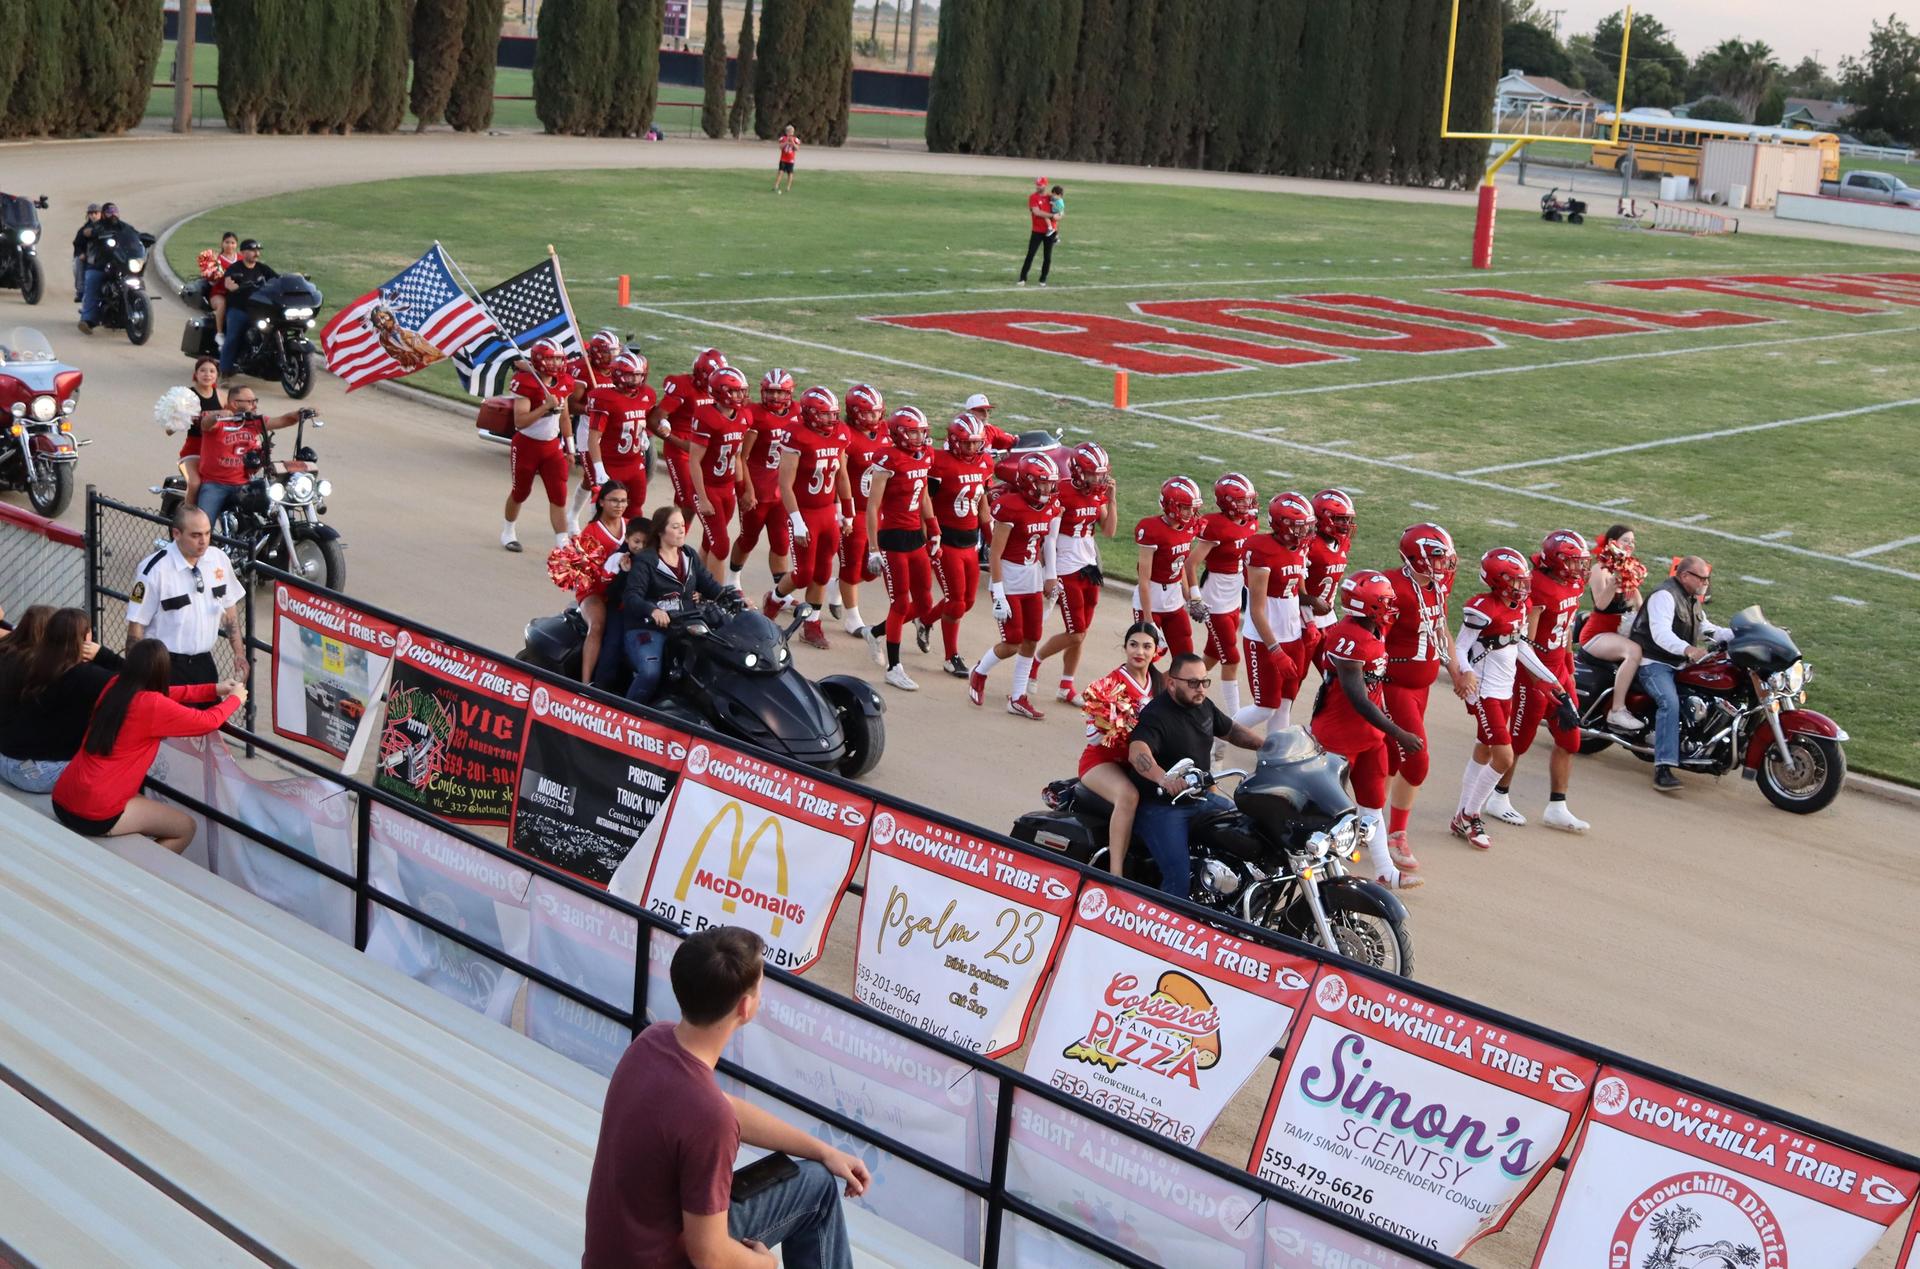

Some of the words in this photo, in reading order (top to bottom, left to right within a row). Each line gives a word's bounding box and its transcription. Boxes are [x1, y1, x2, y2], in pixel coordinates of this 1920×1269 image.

[860, 288, 1788, 376] ROLL
[808, 459, 840, 495] 53
[958, 473, 983, 483] TRIBE
[288, 599, 346, 633] CHOWCHILLA
[349, 622, 377, 644] TRIBE
[309, 597, 332, 610] HOME
[336, 607, 345, 615] OF
[348, 611, 363, 622] THE
[431, 642, 457, 657] HOME
[463, 654, 475, 664] OF
[480, 660, 498, 672] THE
[1335, 637, 1356, 656] 22
[408, 644, 478, 683] CHOWCHILLA
[478, 672, 512, 696] TRIBE
[461, 700, 513, 739] VIC
[549, 700, 623, 742] CHOWCHILLA
[627, 730, 664, 755] TRIBE
[572, 698, 600, 714] HOME
[606, 710, 618, 720] OF
[623, 717, 641, 729] THE
[429, 773, 466, 800] Confess
[470, 786, 497, 804] your
[537, 777, 570, 803] MOBILE:
[628, 765, 666, 793] PRISTINE
[709, 759, 792, 805] CHOWCHILLA
[796, 791, 839, 821] TRIBE
[735, 756, 768, 774] HOME
[774, 771, 788, 781] OF
[794, 778, 815, 791] THE
[608, 808, 631, 825] Central
[617, 787, 643, 812] TRUCK
[895, 828, 991, 877] CHOWCHILLA
[994, 862, 1041, 894] TRIBE
[926, 825, 961, 844] HOME
[968, 839, 984, 851] OF
[991, 847, 1014, 863] THE
[650, 898, 676, 923] 250
[680, 910, 692, 928] E
[694, 869, 805, 925] McDonald's
[878, 885, 980, 954] Psalm
[984, 908, 1044, 964] 23
[1104, 906, 1210, 960] CHOWCHILLA
[1213, 949, 1272, 983] TRIBE
[1137, 902, 1179, 925] HOME
[1187, 923, 1205, 935] OF
[1213, 933, 1242, 950] THE
[969, 982, 979, 995] &
[952, 1029, 981, 1052] Suite
[1119, 1017, 1185, 1051] FAMILY
[1347, 994, 1473, 1060] CHOWCHILLA
[1480, 1043, 1543, 1083] TRIBE
[1387, 993, 1435, 1017] HOME
[1444, 1015, 1465, 1029] OF
[1475, 1025, 1508, 1044] THE
[1085, 1009, 1201, 1091] PIZZA
[1050, 1068, 1196, 1146] 559-665-5713
[1150, 1097, 1163, 1108] CA
[1300, 1033, 1541, 1179] Simon's
[1676, 1097, 1732, 1124] HOME
[1744, 1122, 1768, 1136] OF
[1780, 1133, 1816, 1153] THE
[1283, 1121, 1313, 1143] TAMI
[1313, 1135, 1351, 1159] SIMON
[1361, 1154, 1444, 1198] INDEPENDENT
[1336, 1119, 1473, 1187] SCENTSY
[1629, 1097, 1776, 1167] CHOWCHILLA
[1783, 1151, 1857, 1194] TRIBE
[1263, 1148, 1374, 1205] 559-479-6626
[1629, 1174, 1738, 1222] Chowchilla
